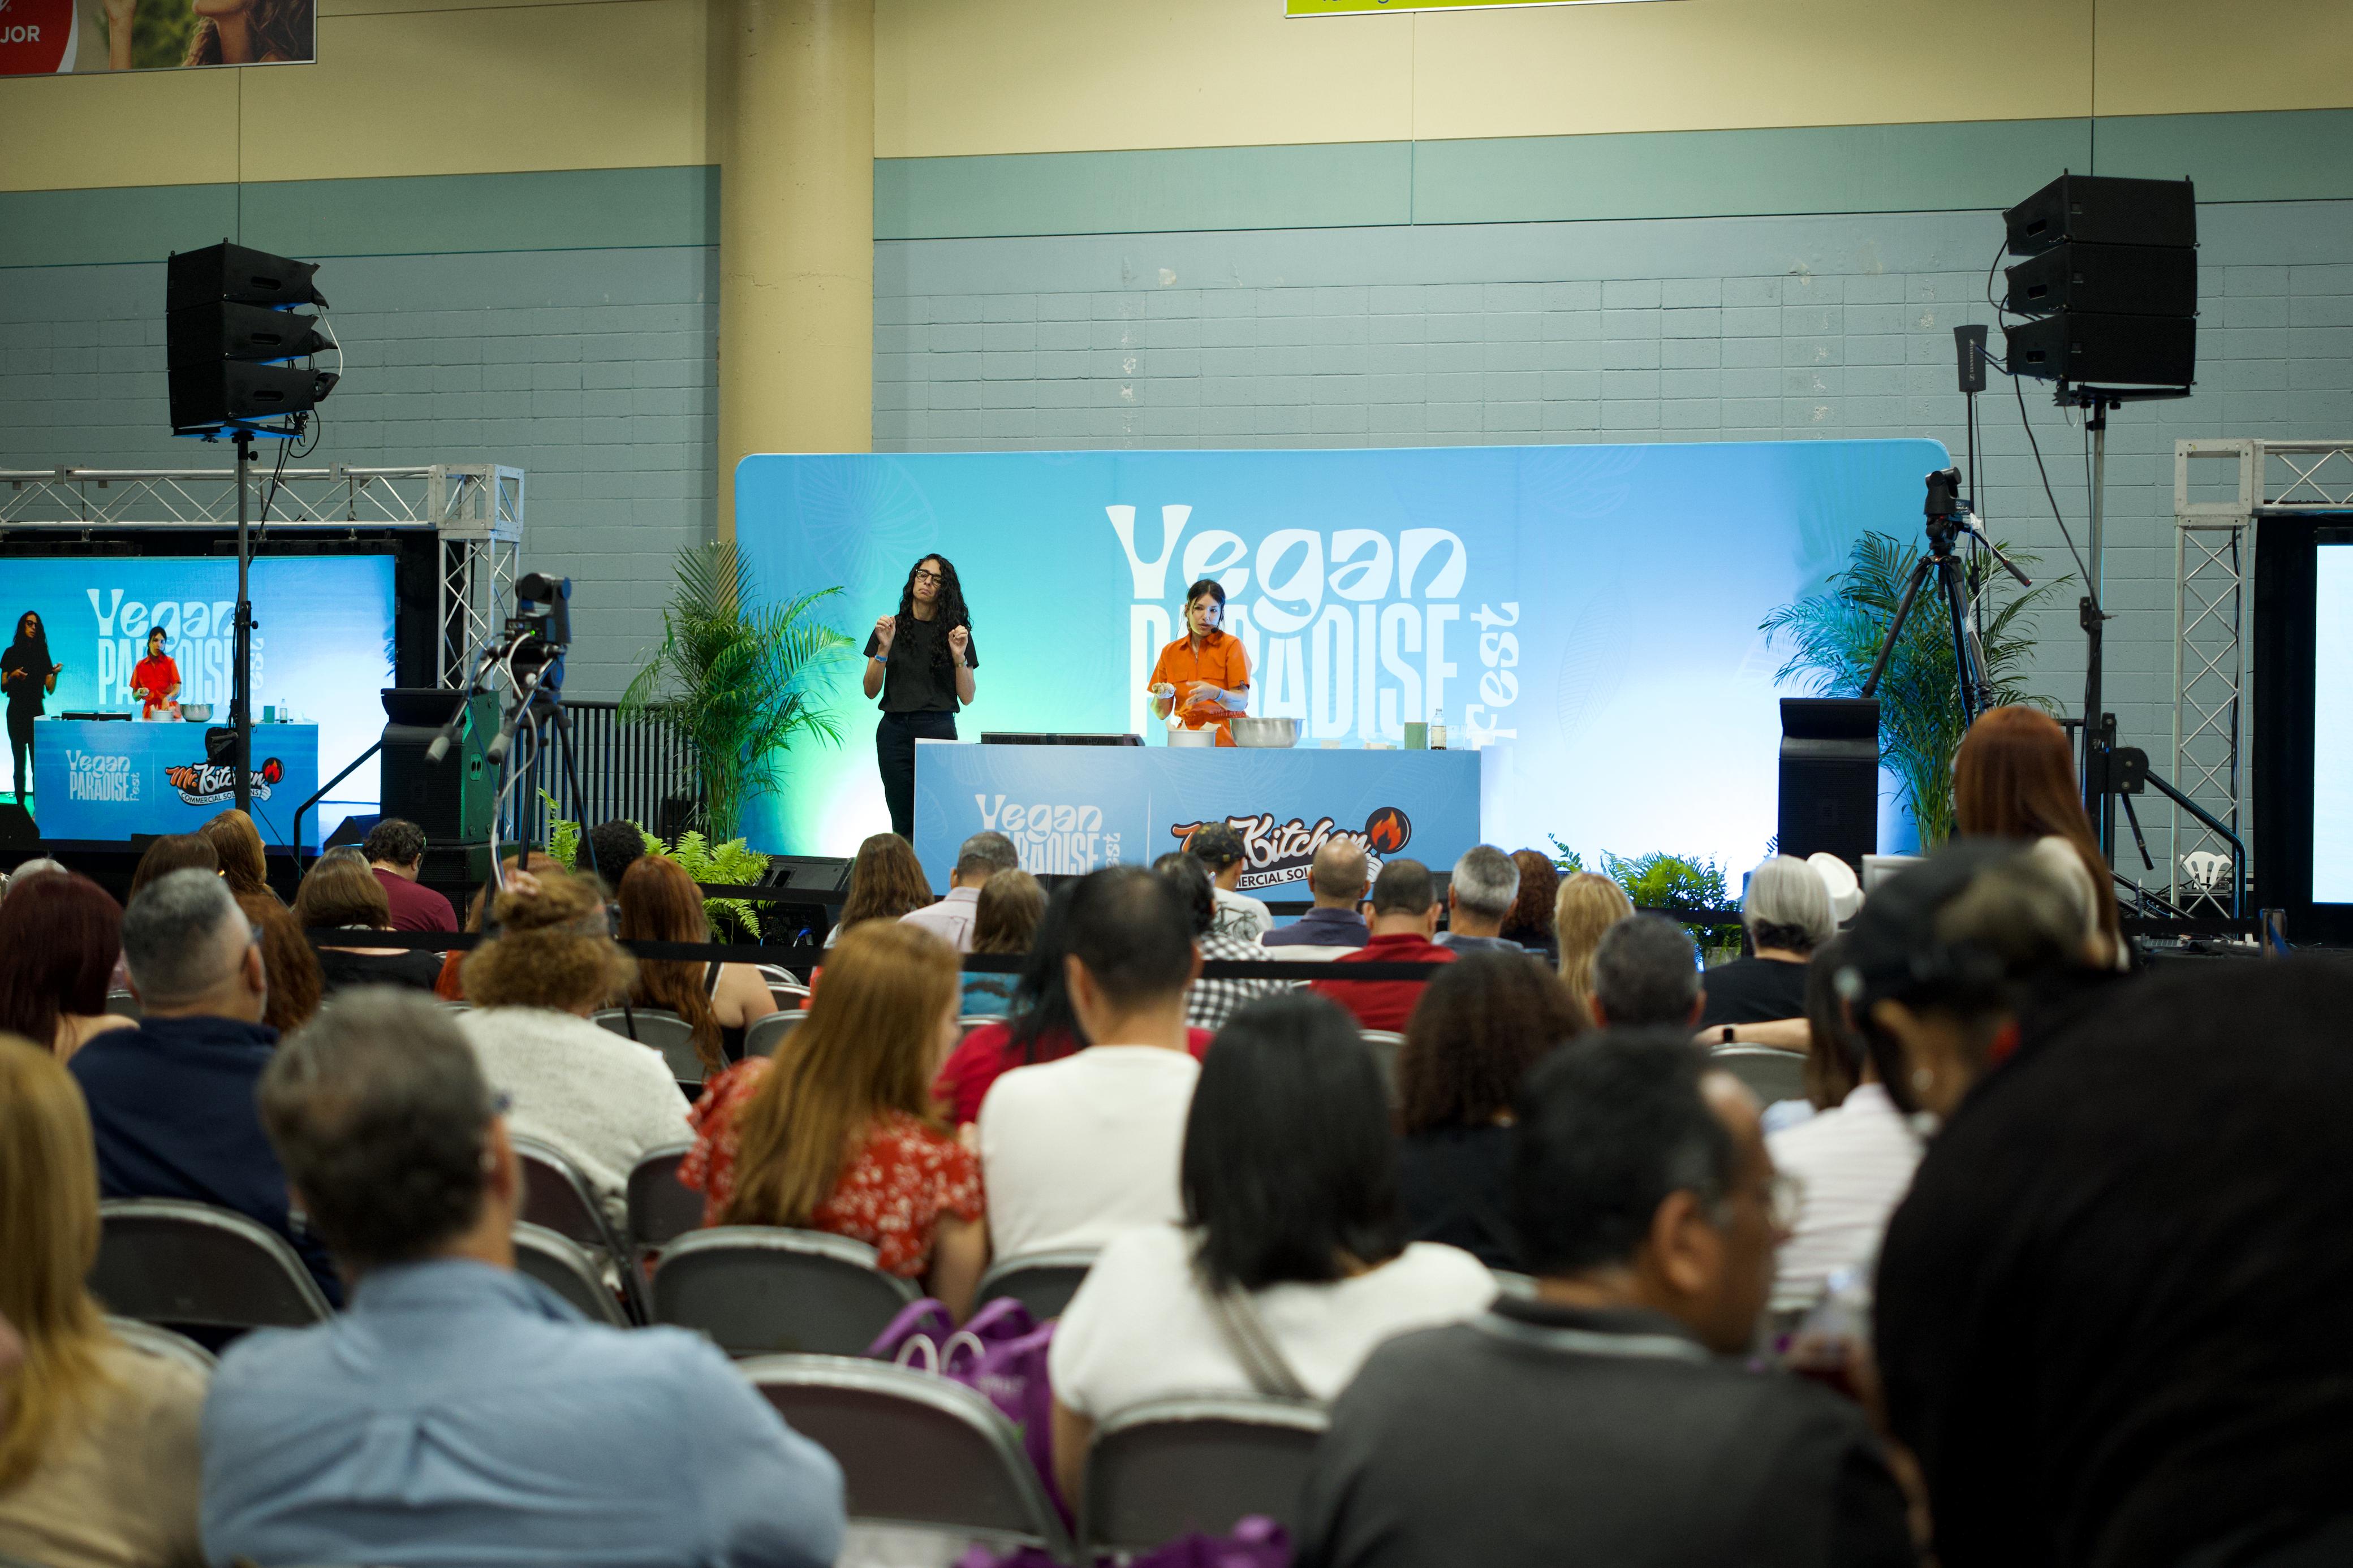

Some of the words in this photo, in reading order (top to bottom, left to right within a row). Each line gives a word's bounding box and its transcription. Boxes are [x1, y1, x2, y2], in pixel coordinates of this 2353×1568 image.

[1105, 504, 1467, 633] Vegan
[66, 749, 131, 779] Vegan
[165, 766, 197, 789] Mr.
[70, 771, 130, 802] PARADISE
[181, 792, 222, 804] COMMERCIAL
[975, 794, 1103, 843] Vegan
[1000, 831, 1100, 875] RADISE
[1102, 832, 1121, 868] est
